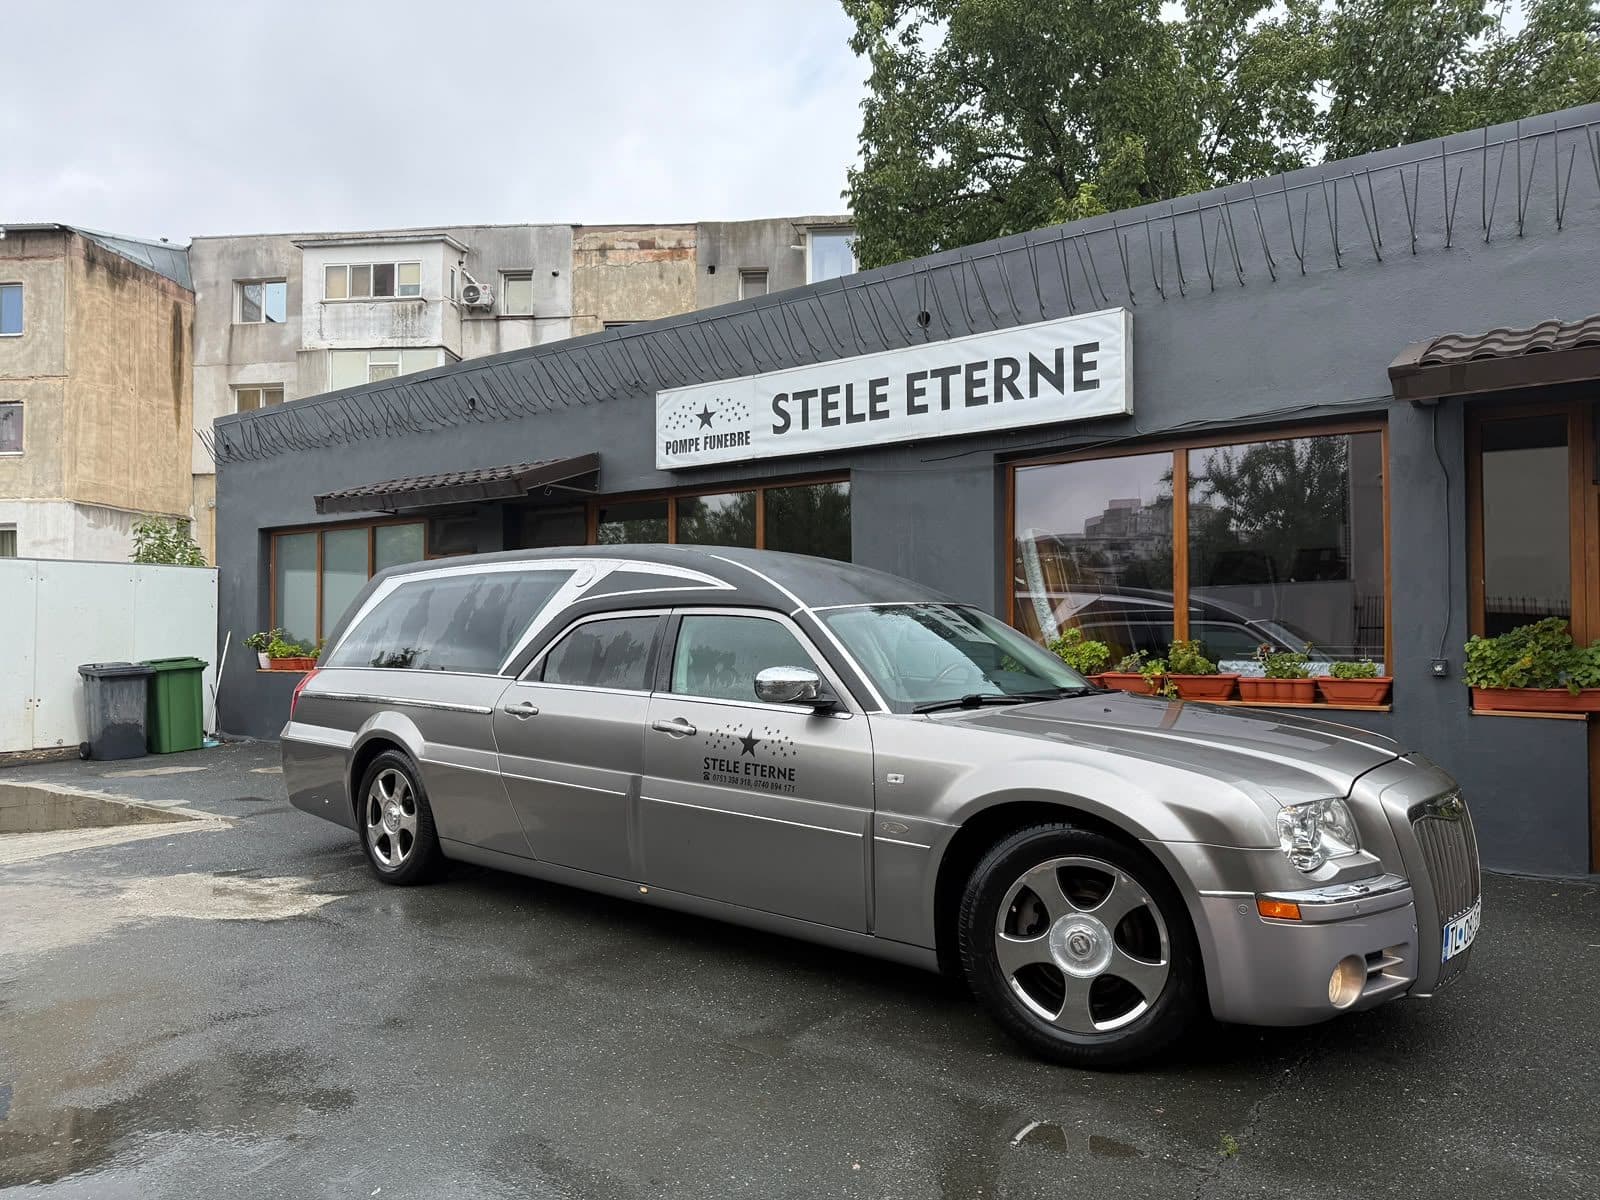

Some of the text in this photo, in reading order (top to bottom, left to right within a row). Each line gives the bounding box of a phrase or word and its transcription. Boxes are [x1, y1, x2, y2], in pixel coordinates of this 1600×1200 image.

[772, 341, 1100, 434] STELE ETERNE
[665, 430, 751, 455] POMPE FUNEBRE
[703, 757, 796, 781] STELE ETERNE
[754, 779, 770, 789] 0740
[784, 784, 796, 793] 171
